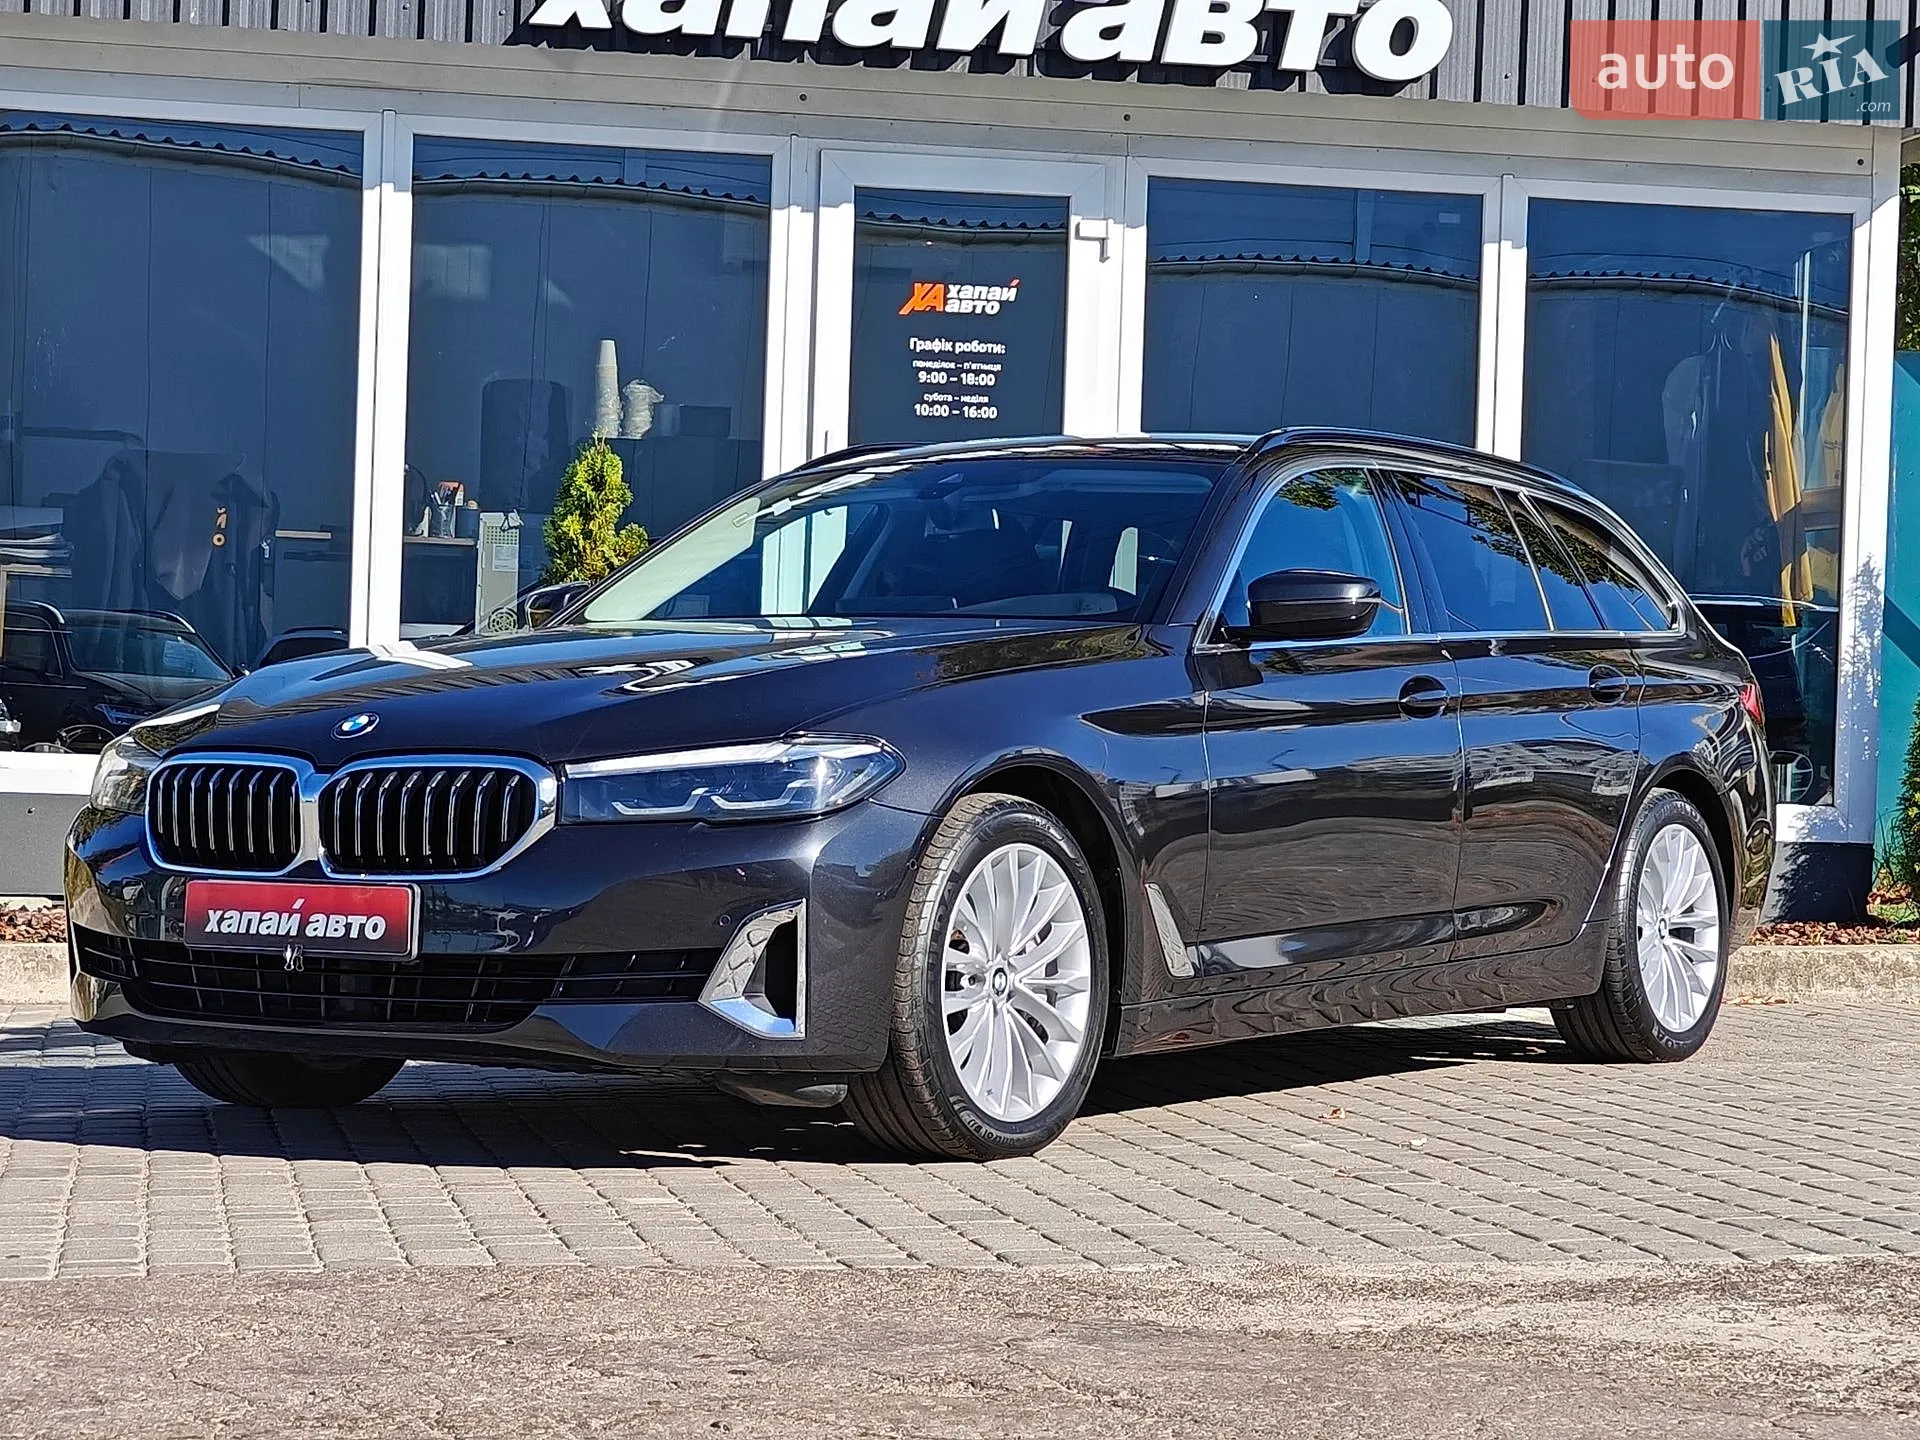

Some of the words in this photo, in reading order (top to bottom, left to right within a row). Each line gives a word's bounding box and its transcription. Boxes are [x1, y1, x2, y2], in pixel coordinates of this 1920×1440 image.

[1060, 0, 1454, 81] авто
[946, 279, 1020, 301] хапай
[945, 299, 1001, 315] авто
[909, 337, 953, 353] Графік
[955, 340, 1006, 354] роботи:
[918, 371, 948, 384] 9:00
[960, 373, 996, 386] 18:00
[923, 393, 953, 403] субота
[960, 394, 989, 403] неділя
[914, 404, 949, 417] 10:00
[963, 406, 998, 419] 16:00
[205, 898, 305, 936] хапай
[305, 913, 386, 940] авто
